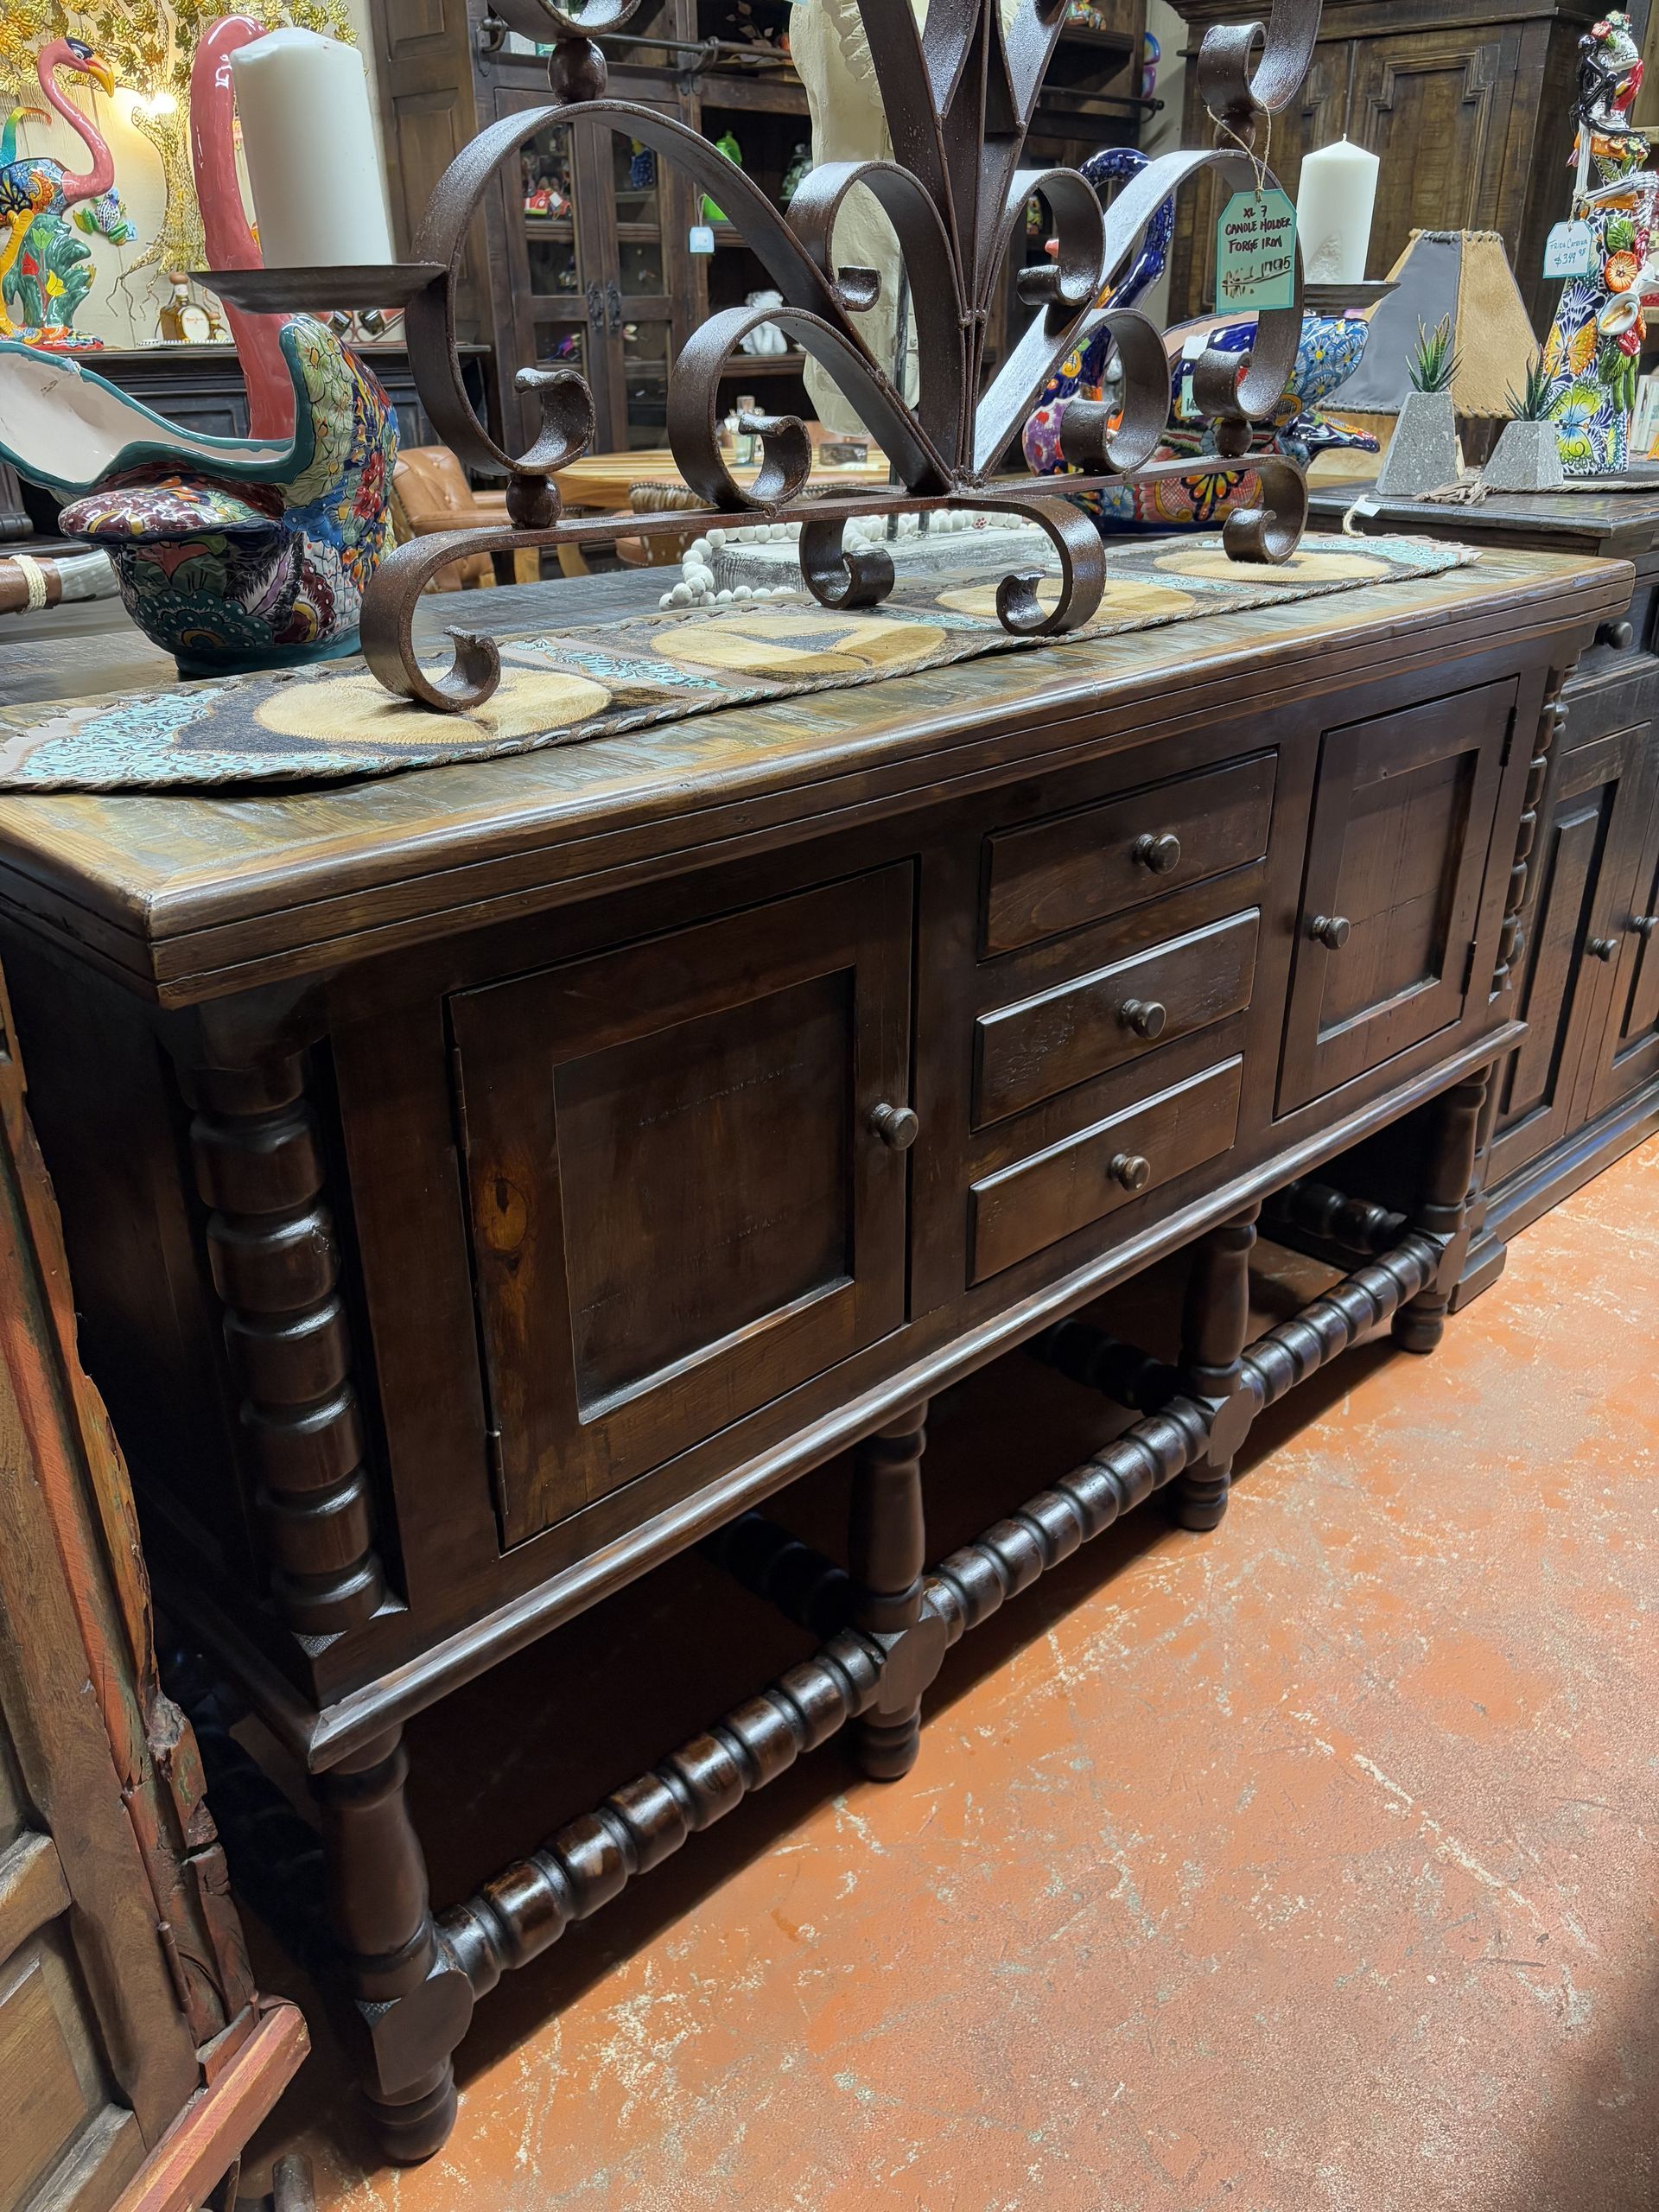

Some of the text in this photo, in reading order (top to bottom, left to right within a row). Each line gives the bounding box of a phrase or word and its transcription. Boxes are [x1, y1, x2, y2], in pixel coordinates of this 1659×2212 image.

[1225, 217, 1292, 236] CANDLE HOLDER
[1228, 238, 1260, 253] FORGE
